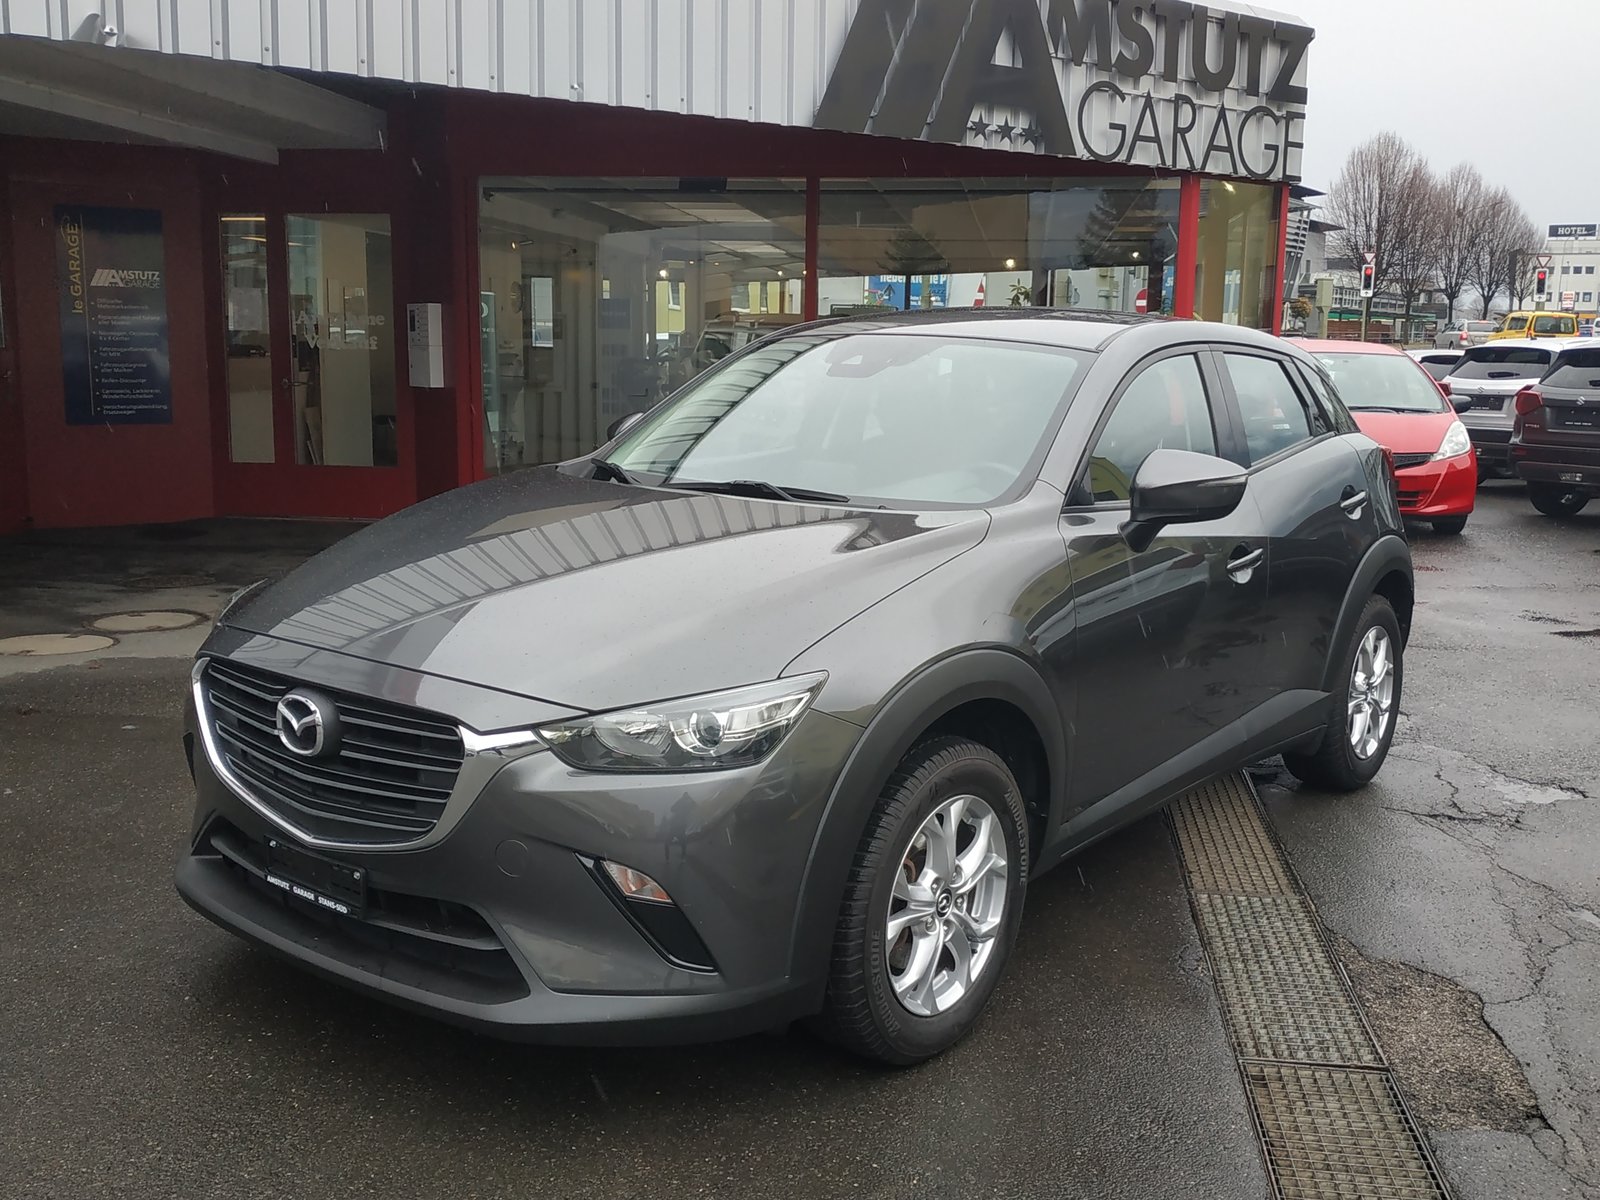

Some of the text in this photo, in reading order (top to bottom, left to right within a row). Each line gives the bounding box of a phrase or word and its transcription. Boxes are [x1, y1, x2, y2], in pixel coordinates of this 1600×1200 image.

[925, 0, 1315, 157] AMSTUTZ
[1077, 80, 1305, 182] GARAGE
[67, 223, 83, 314] le GARAGE
[1557, 227, 1588, 235] HOTEL
[105, 269, 160, 287] AMSTUTZ
[122, 279, 161, 289] GARAGE
[1004, 788, 1028, 886] BRIDGESTONE
[293, 886, 315, 901] GARAGE
[870, 930, 901, 1036] BRIDGESTONE
